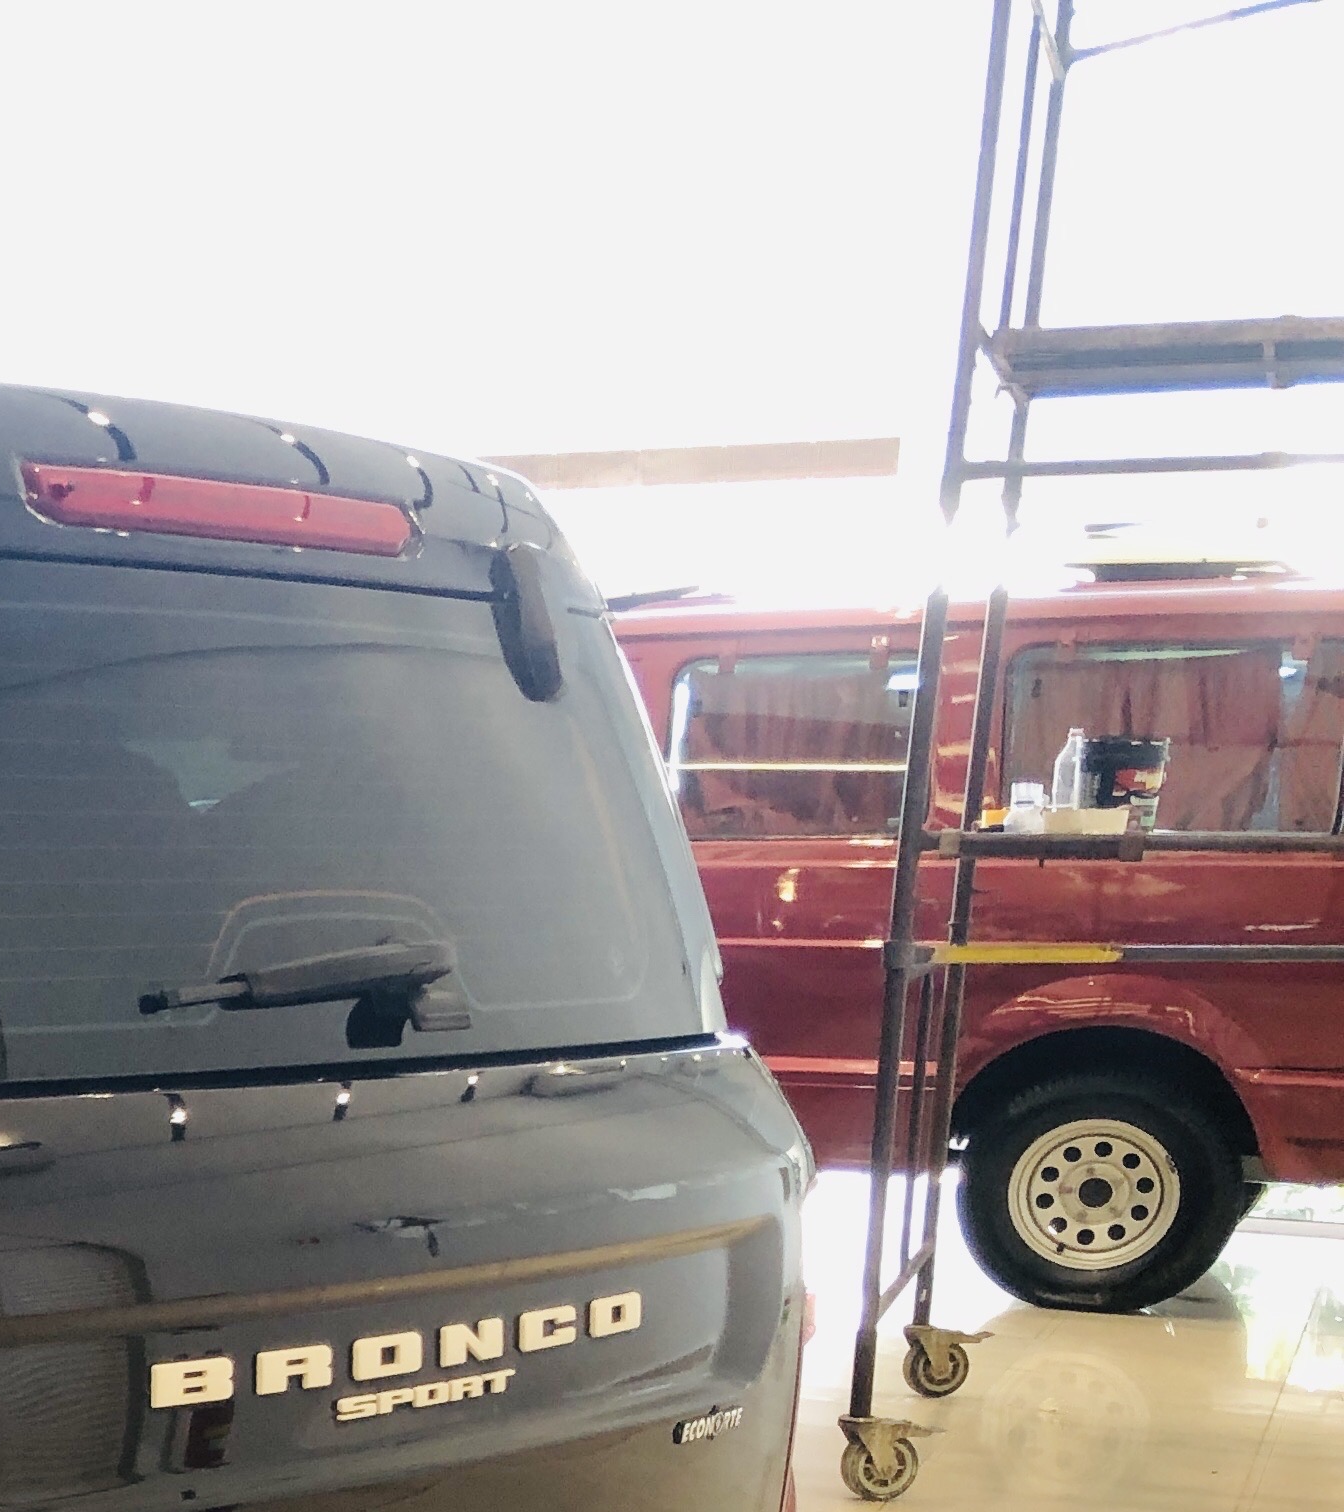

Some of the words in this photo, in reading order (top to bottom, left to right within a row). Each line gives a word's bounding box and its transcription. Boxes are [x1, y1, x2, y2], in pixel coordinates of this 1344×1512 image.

[150, 1291, 642, 1408] BRONCO
[336, 1368, 516, 1421] SPORT
[681, 1407, 743, 1443] ECONORTE
